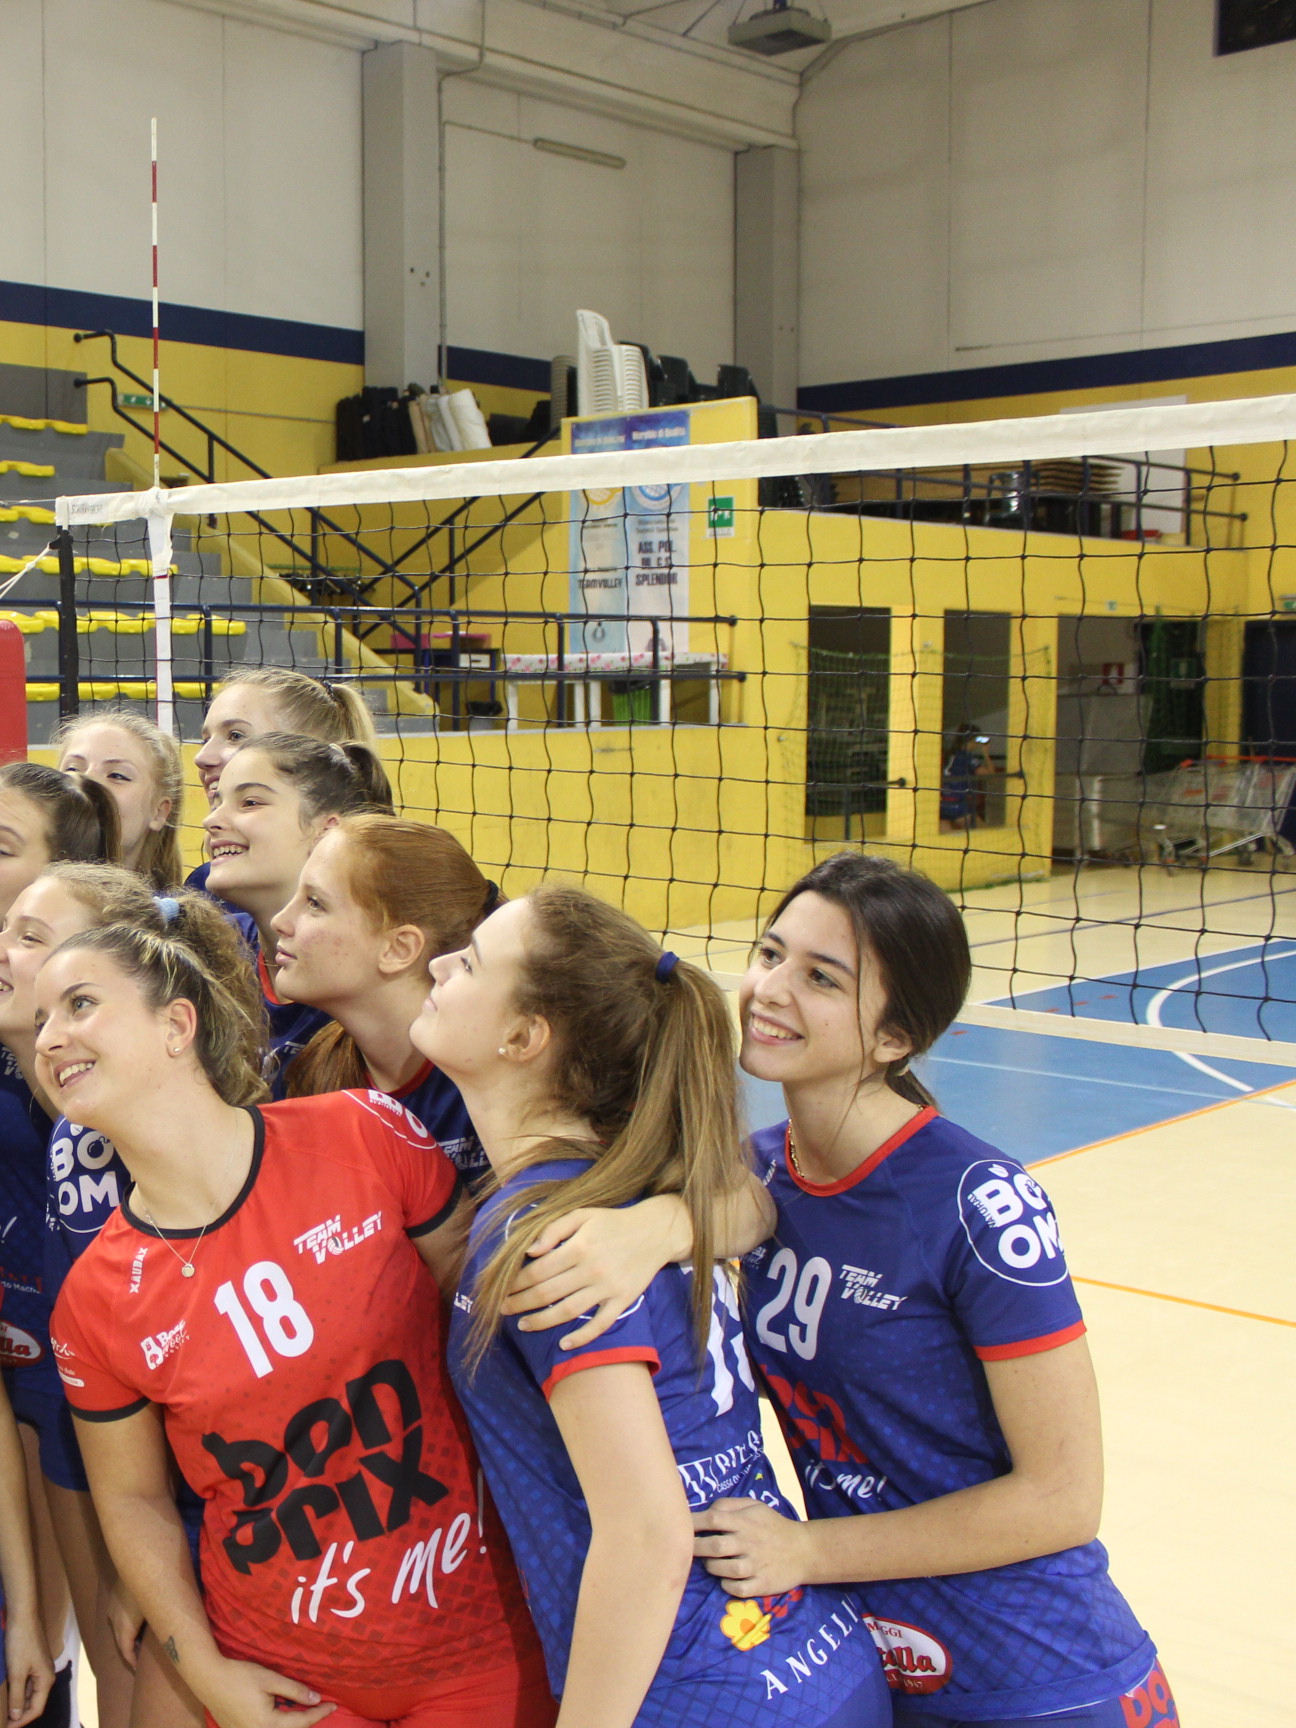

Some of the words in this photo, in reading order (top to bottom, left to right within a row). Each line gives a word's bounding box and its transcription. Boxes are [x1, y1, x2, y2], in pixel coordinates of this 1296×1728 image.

[636, 572, 678, 586] SPLENDOR
[293, 1215, 344, 1255] TEAM
[967, 1193, 997, 1229] NATURAL
[314, 1211, 383, 1265] VOLLEY
[129, 1247, 149, 1293] XAUDAX
[839, 1264, 885, 1287] TEAM
[214, 1260, 315, 1379] 18
[755, 1247, 832, 1361] 29
[841, 1282, 908, 1312] VOLLEY
[201, 1359, 423, 1506] bon
[222, 1425, 450, 1576] prix
[291, 1540, 372, 1624] it's
[391, 1467, 488, 1609] me!
